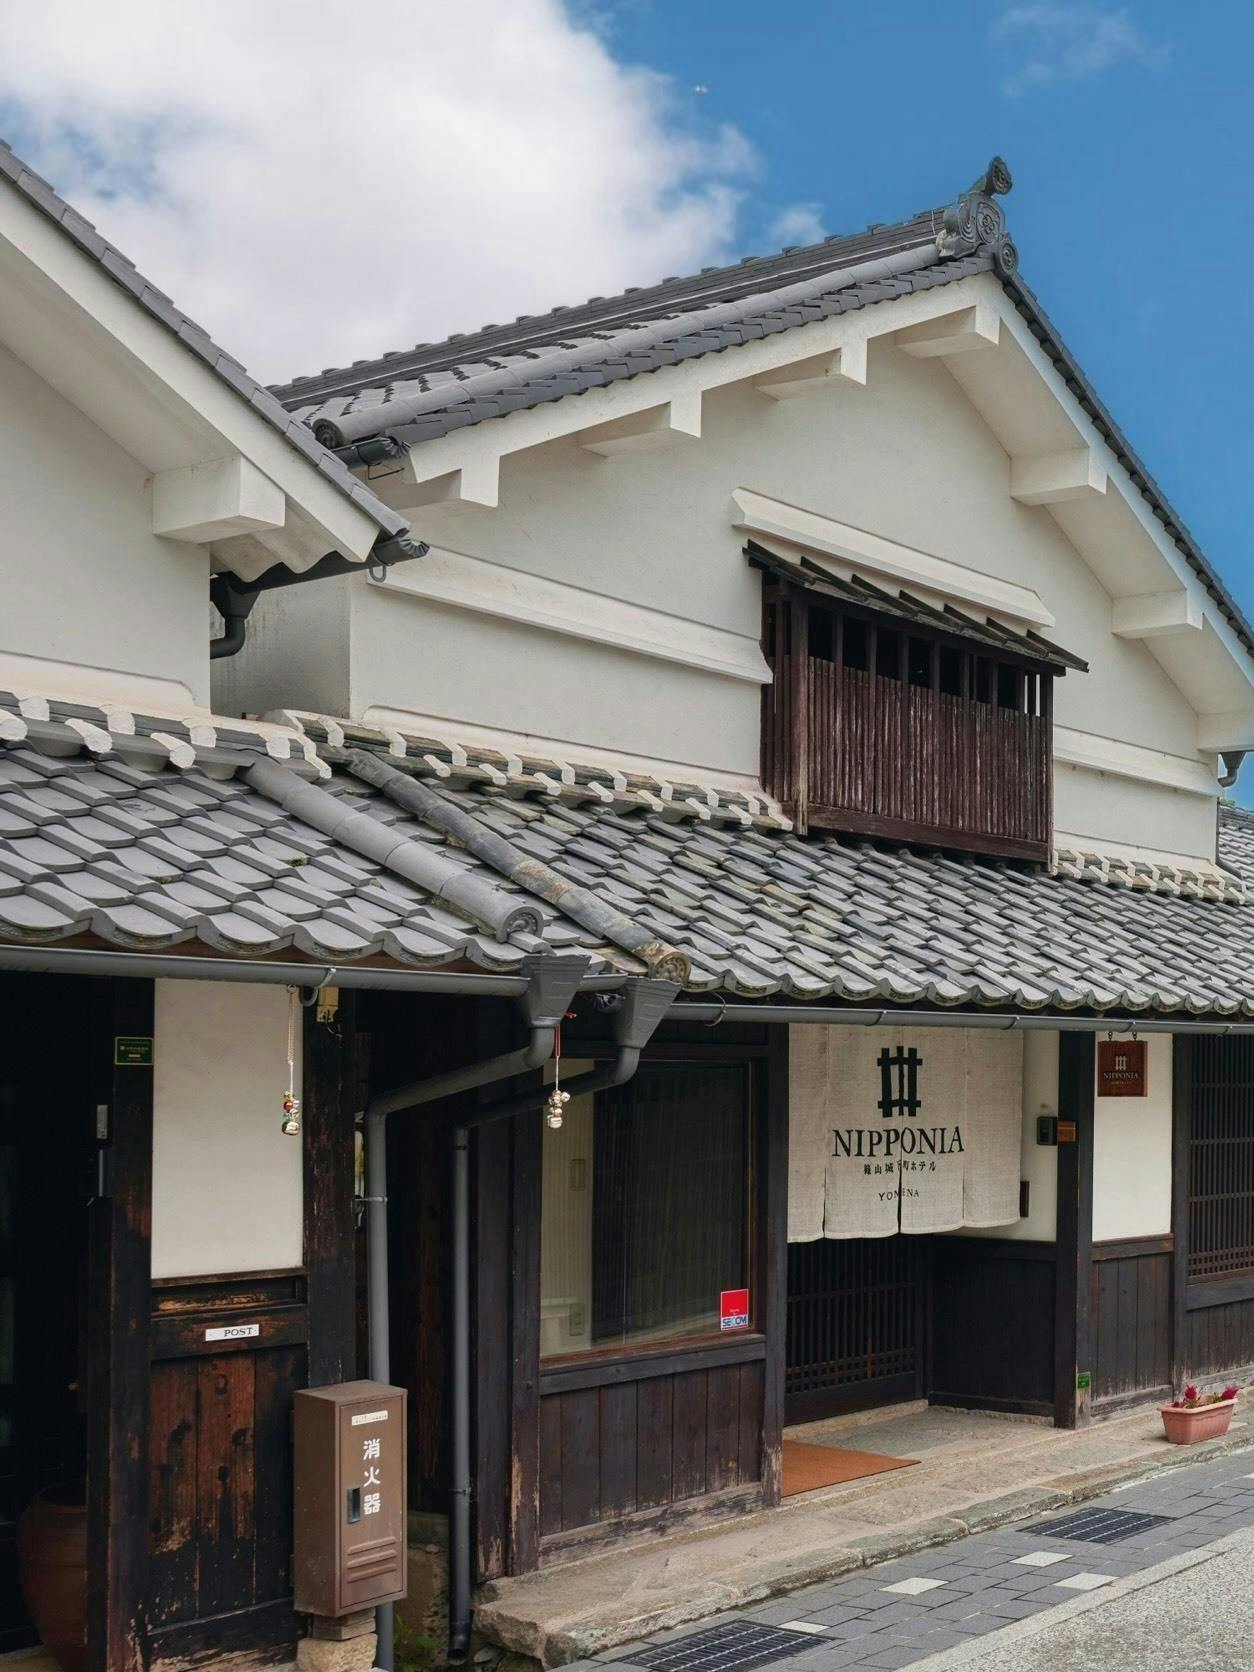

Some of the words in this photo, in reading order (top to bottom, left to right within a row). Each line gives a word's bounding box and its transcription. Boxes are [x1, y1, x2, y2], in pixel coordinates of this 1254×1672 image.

[832, 1126, 964, 1157] NIPPONIA
[224, 1327, 253, 1337] POST
[722, 1316, 747, 1327] SECOM
[363, 1438, 381, 1515] 消火器
